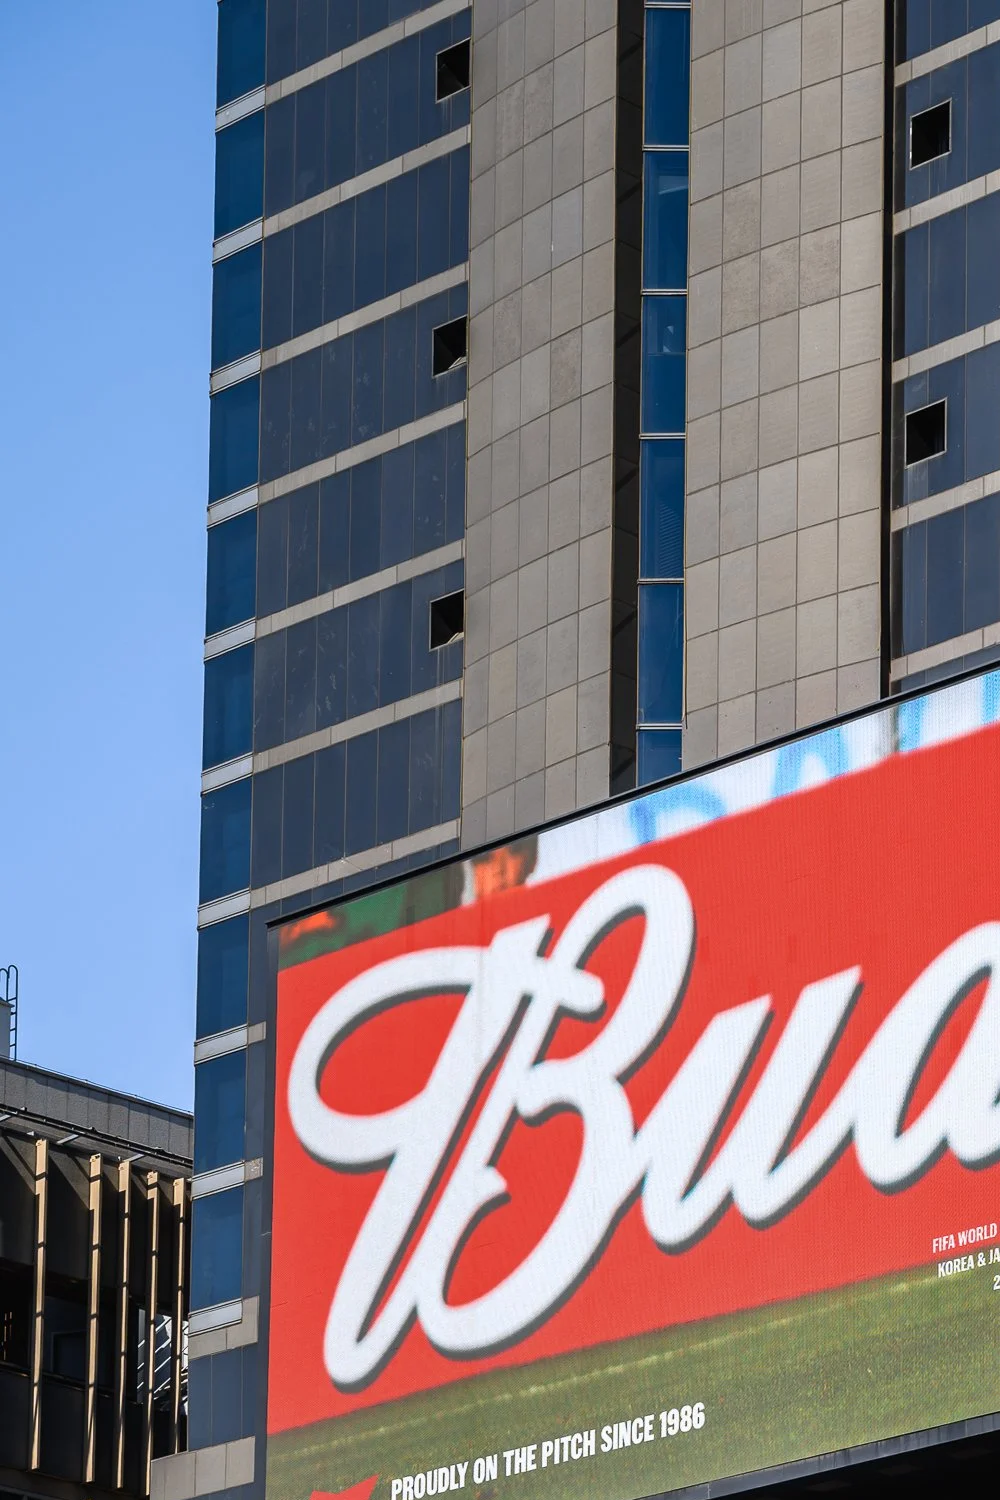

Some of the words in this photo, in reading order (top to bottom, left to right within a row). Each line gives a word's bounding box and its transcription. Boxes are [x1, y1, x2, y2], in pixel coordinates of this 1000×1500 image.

[933, 1234, 956, 1254] FIFA
[958, 1223, 998, 1246] WORLD
[938, 1255, 975, 1278] KOREA
[977, 1252, 986, 1267] &
[473, 1455, 498, 1484] ON
[503, 1445, 537, 1477] THE
[542, 1429, 596, 1468] PITCH
[601, 1414, 655, 1453] SINCE
[659, 1402, 706, 1438] 1986
